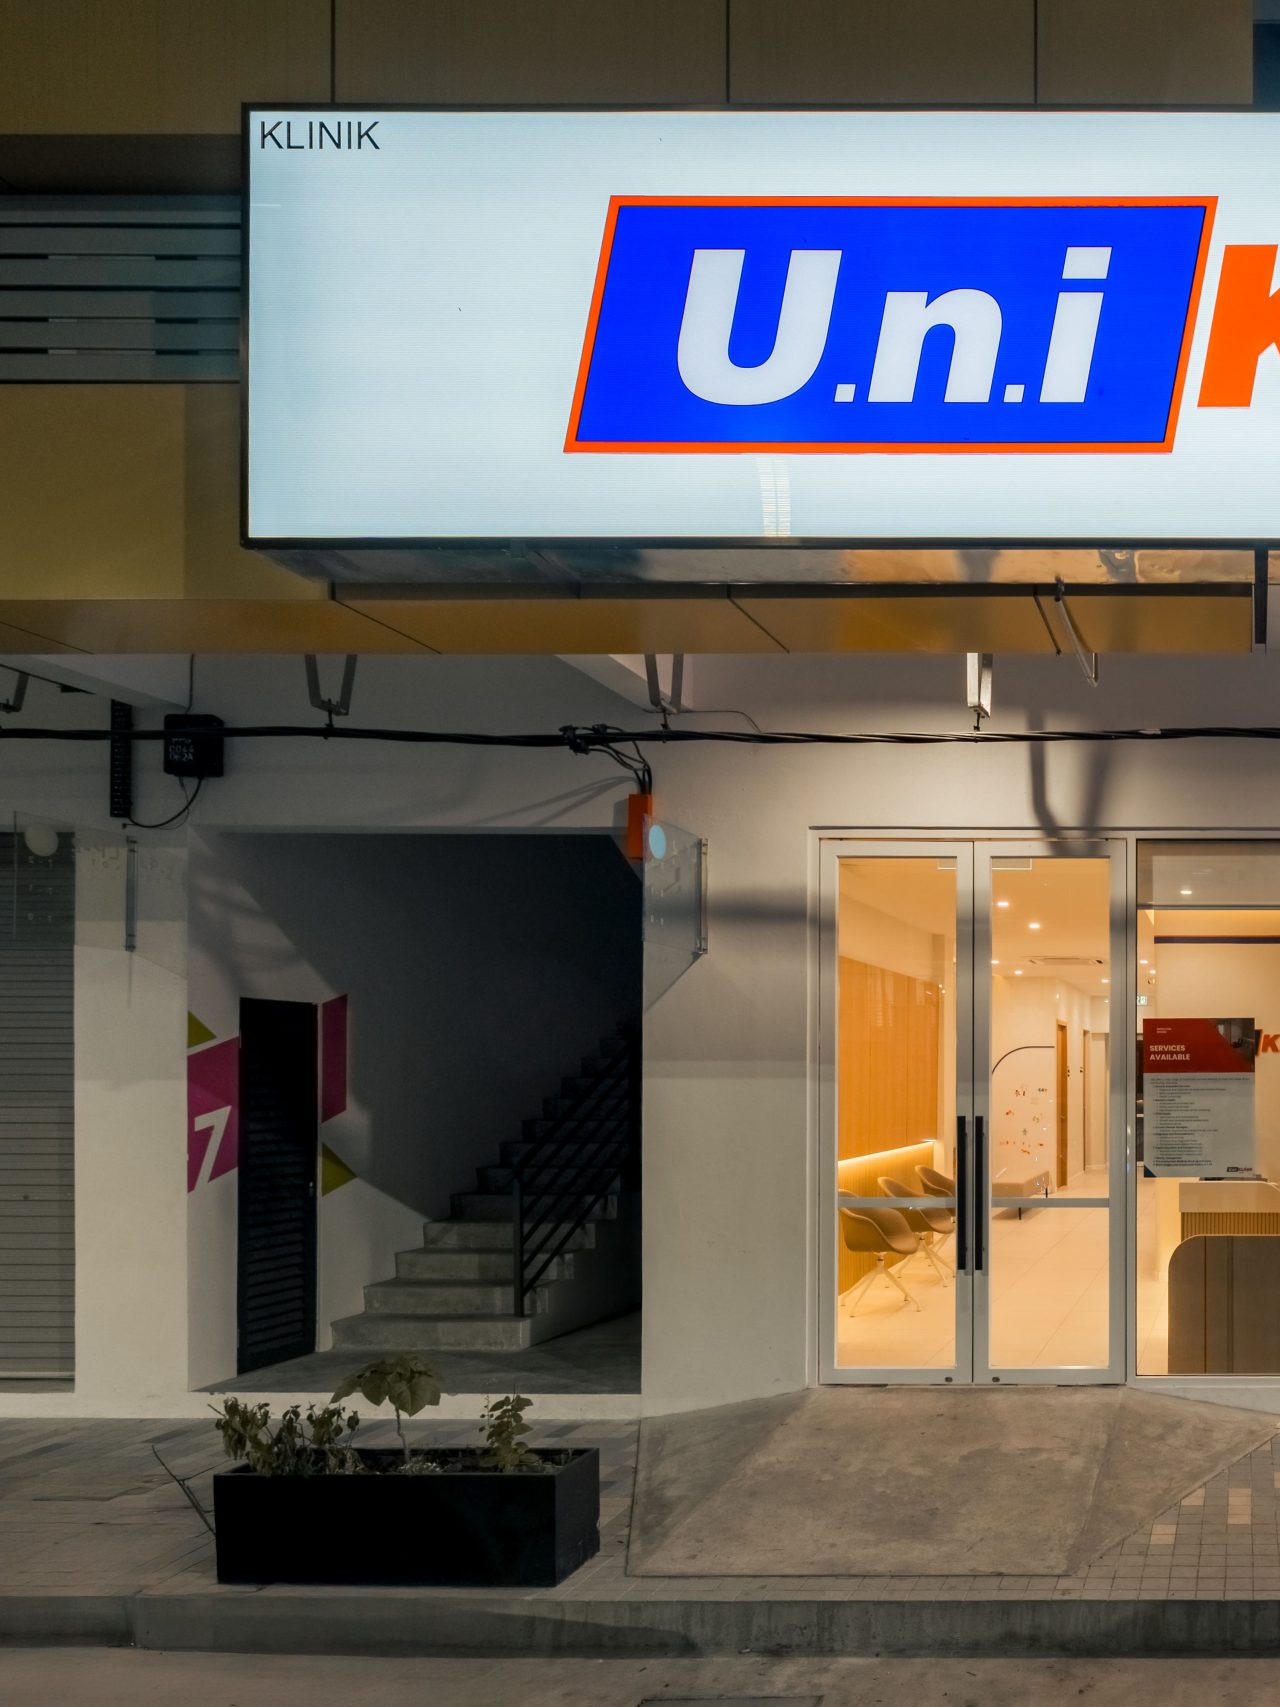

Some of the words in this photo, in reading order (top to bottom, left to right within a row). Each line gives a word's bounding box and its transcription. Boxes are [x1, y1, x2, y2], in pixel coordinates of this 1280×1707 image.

[259, 119, 381, 151] KLINIK
[1149, 1045, 1186, 1053] SERVICES
[1149, 1053, 1191, 1062] AVAILABLE
